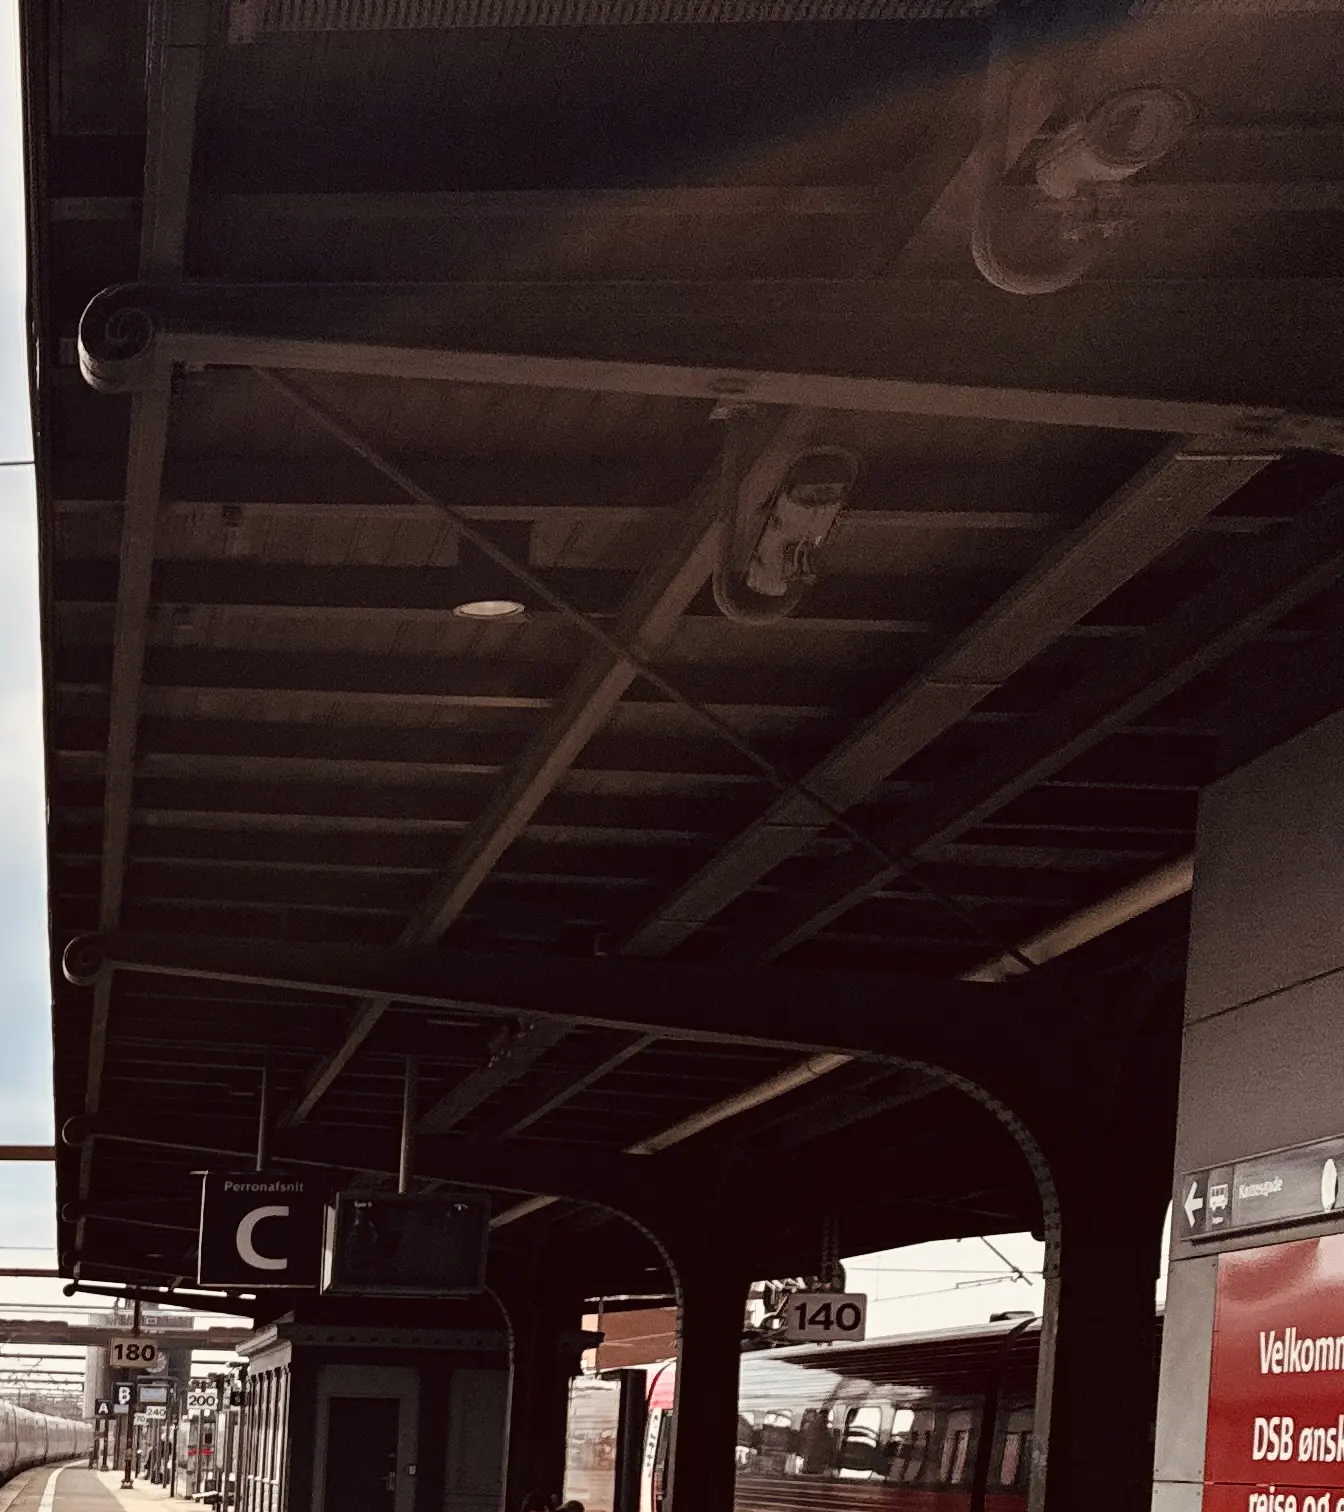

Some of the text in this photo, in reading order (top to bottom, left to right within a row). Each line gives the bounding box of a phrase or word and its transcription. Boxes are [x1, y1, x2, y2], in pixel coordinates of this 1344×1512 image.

[224, 1181, 305, 1192] Perronafsnit
[236, 1205, 289, 1270] C
[794, 1302, 861, 1331] 140
[114, 1343, 156, 1362] 180
[118, 1386, 131, 1402] B
[188, 1395, 216, 1406] 200
[98, 1402, 109, 1414] A
[147, 1408, 166, 1416] 240
[1252, 1416, 1294, 1462] DSB
